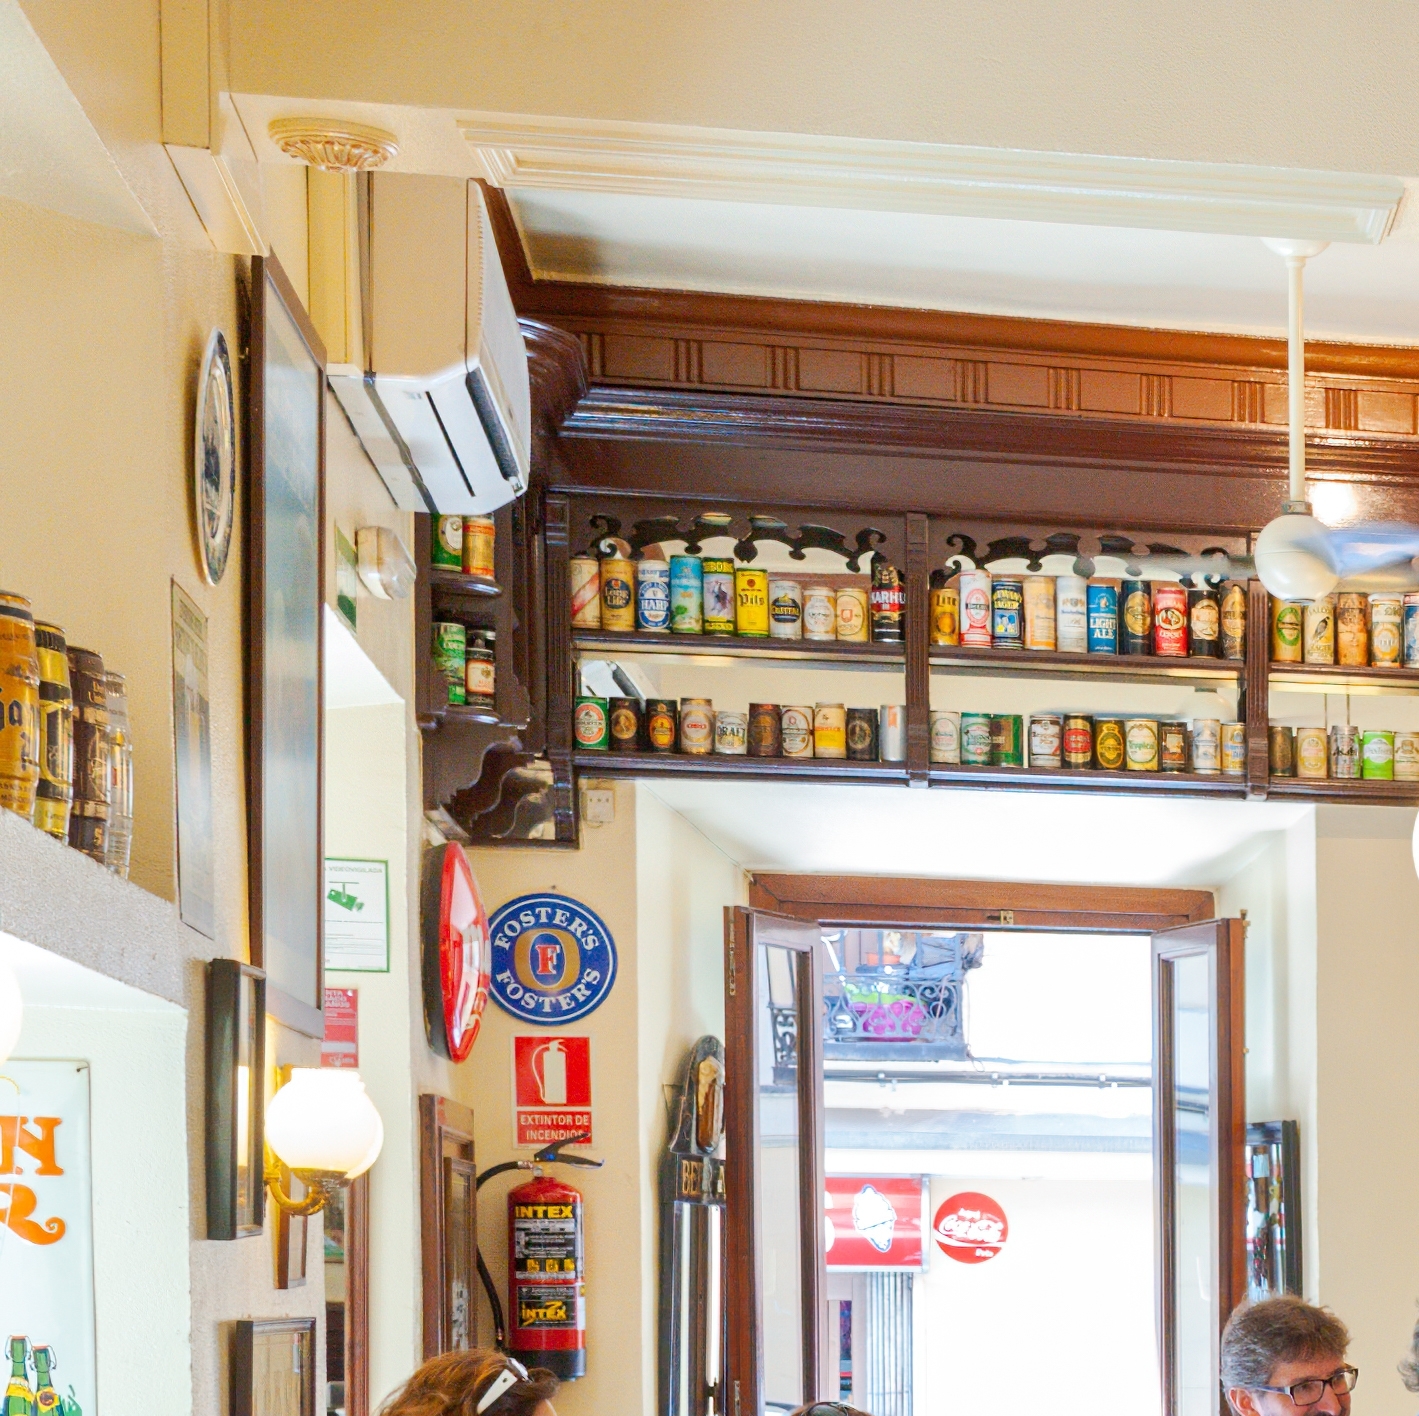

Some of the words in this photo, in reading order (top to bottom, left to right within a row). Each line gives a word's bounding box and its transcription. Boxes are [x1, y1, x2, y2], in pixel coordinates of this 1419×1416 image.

[738, 593, 765, 608] Pils
[1093, 628, 1115, 640] ALE
[494, 906, 600, 951] FOSTER'S
[495, 967, 601, 1013] FOSTER'S
[520, 1114, 573, 1126] EXTINTOR
[575, 1114, 590, 1125] DE
[515, 1205, 573, 1219] INTEX
[521, 1307, 567, 1321] INTEX
